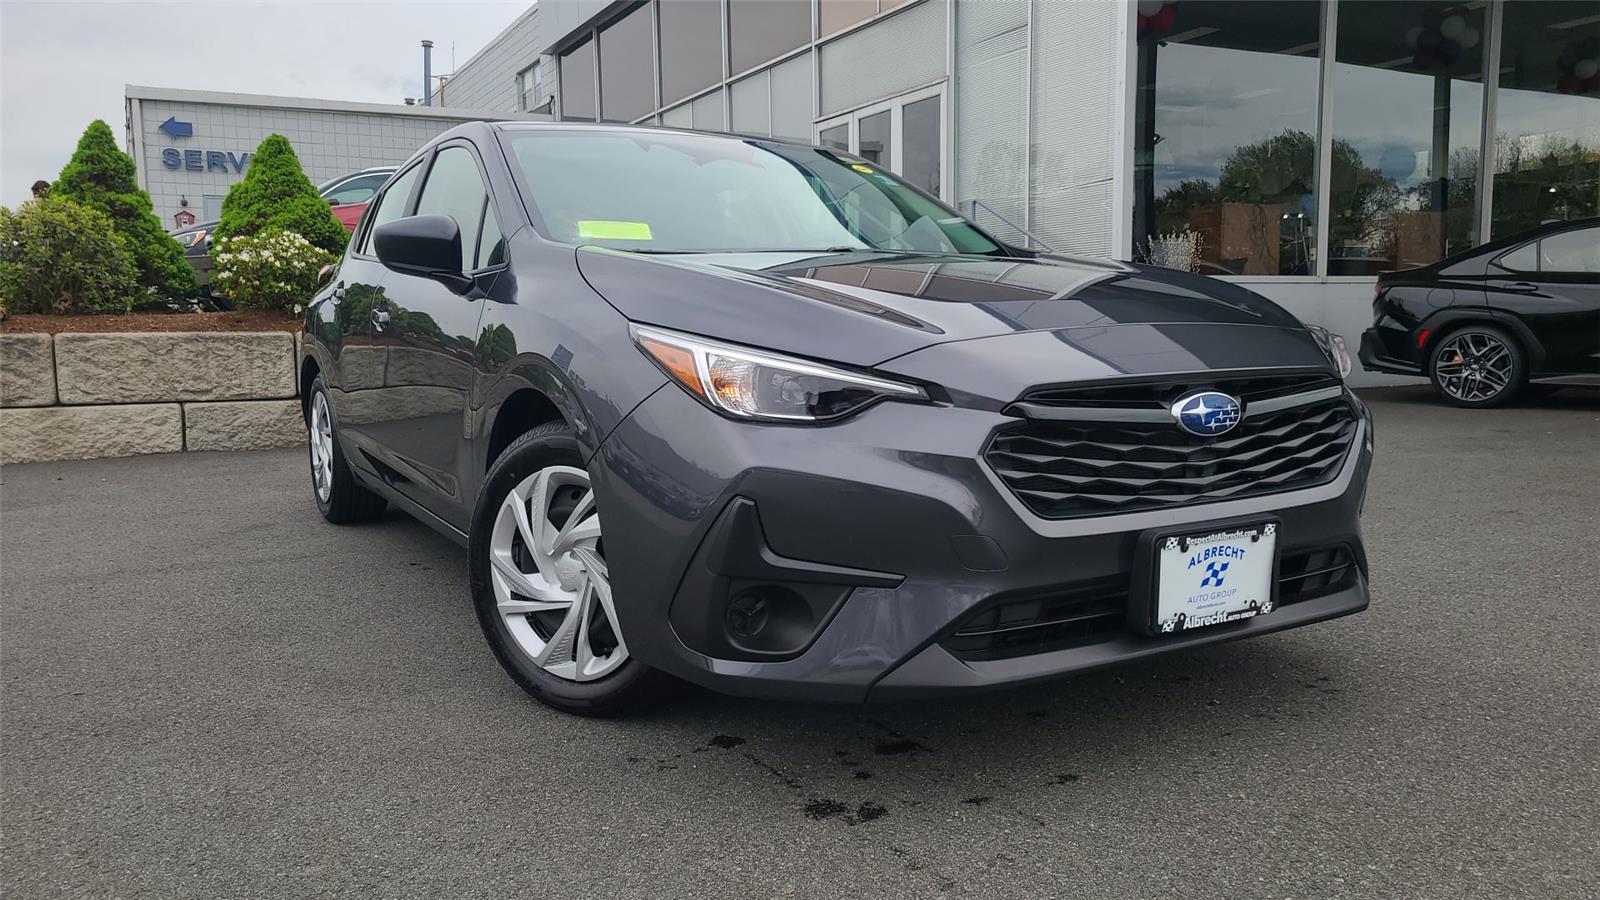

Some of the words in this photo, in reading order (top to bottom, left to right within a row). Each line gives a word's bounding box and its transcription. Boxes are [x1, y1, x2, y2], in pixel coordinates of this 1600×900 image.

[162, 148, 254, 173] SERV
[1186, 530, 1257, 546] RespectAtAlbrecht.com
[1188, 546, 1245, 569] ALBRECHT
[1187, 592, 1209, 604] AUTO
[1210, 588, 1237, 600] GROUP
[1183, 610, 1228, 629] Albrecht
